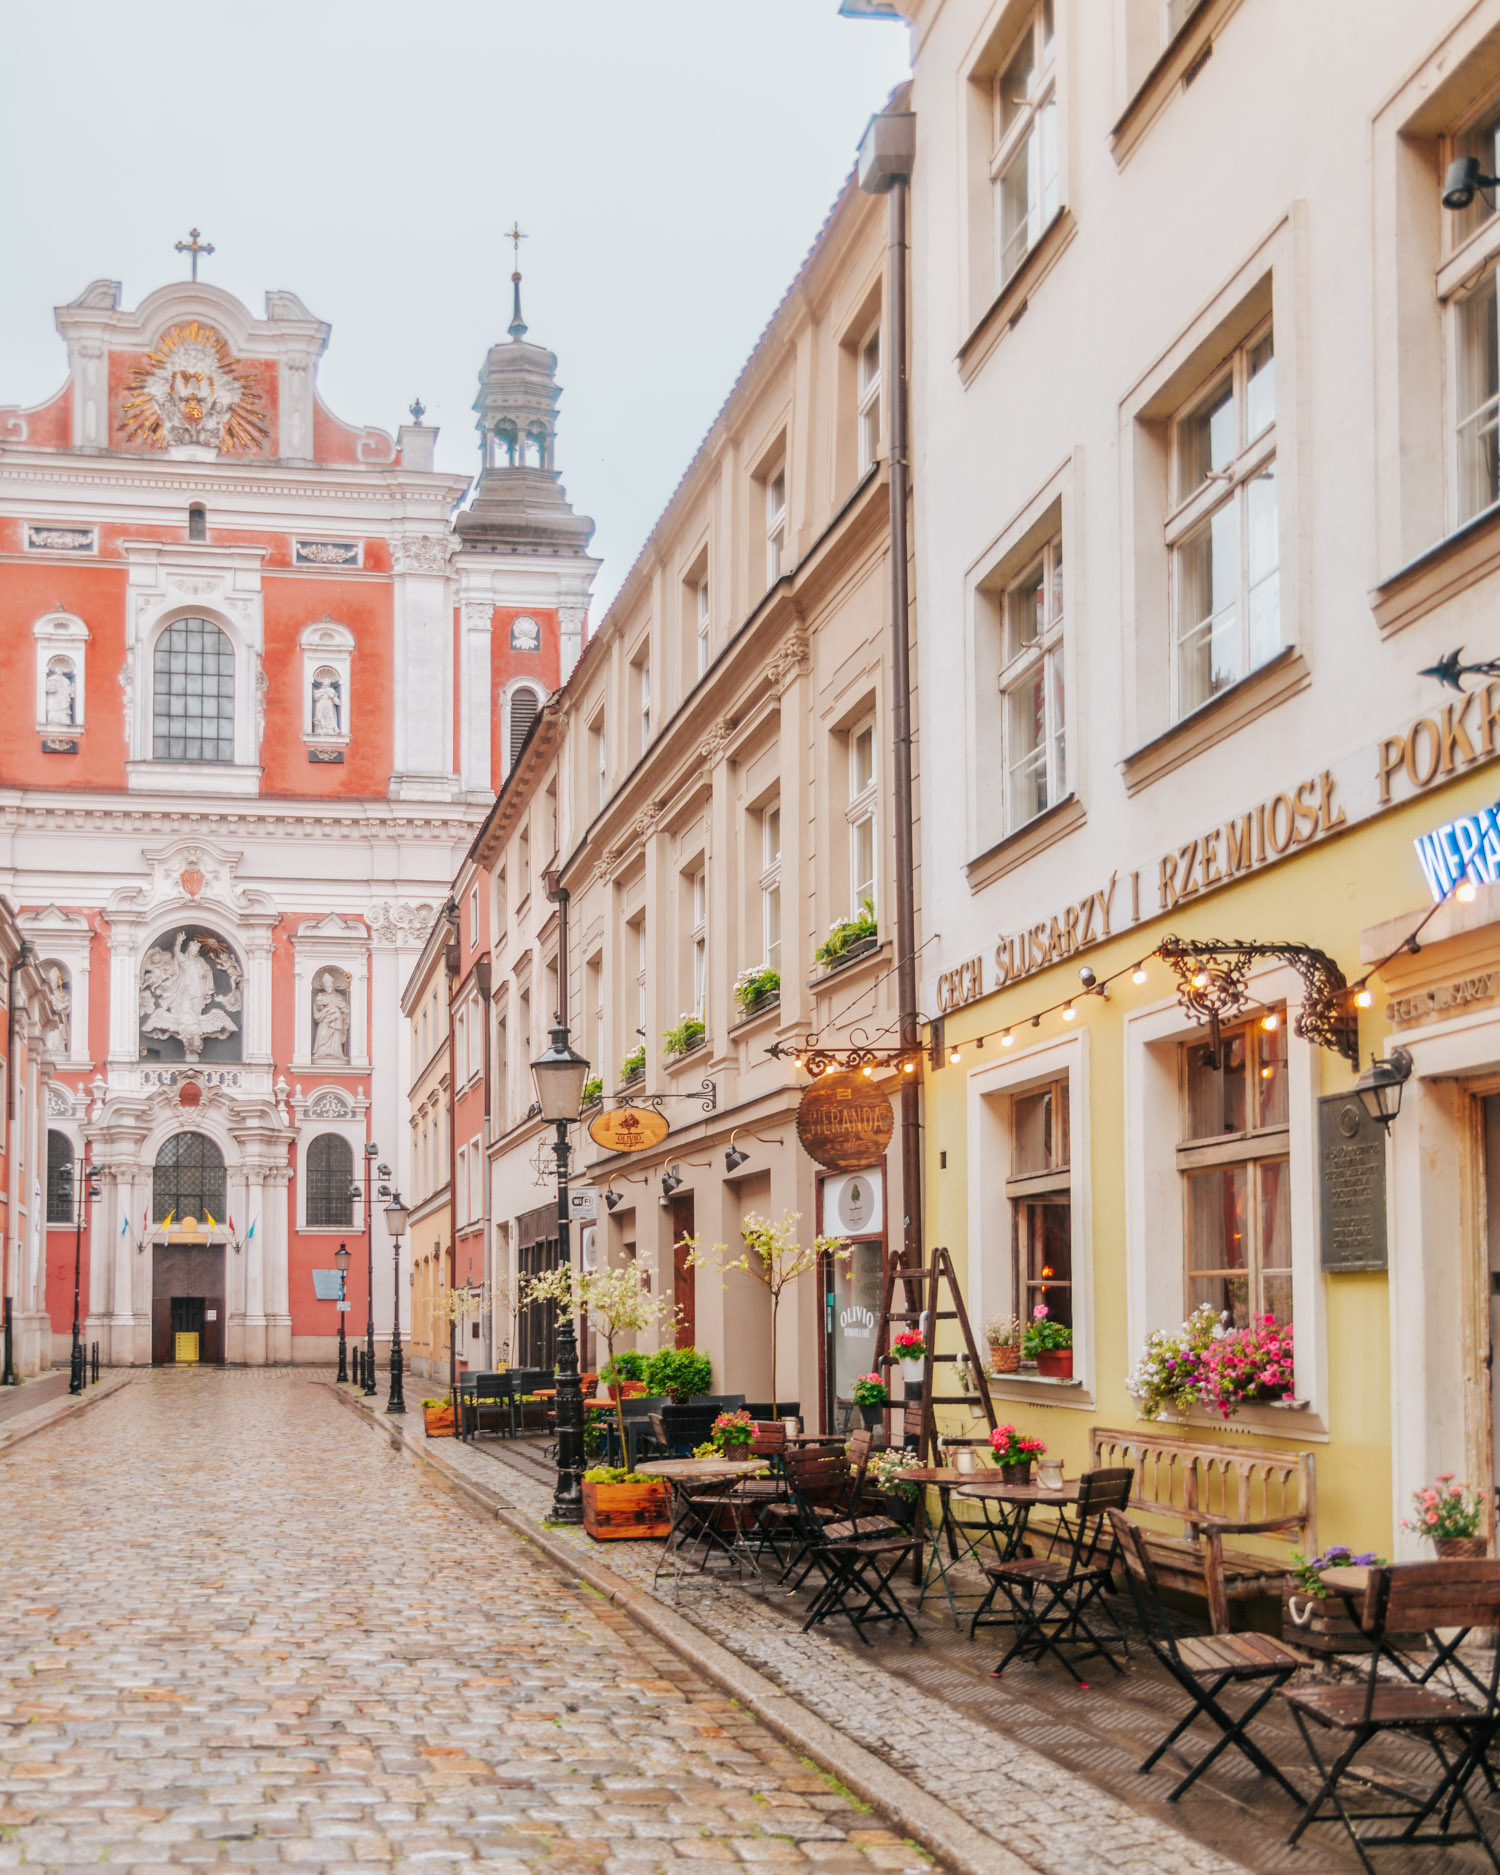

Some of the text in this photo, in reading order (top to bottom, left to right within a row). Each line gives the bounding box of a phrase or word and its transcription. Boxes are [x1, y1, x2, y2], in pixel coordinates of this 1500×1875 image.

[1413, 806, 1500, 904] WERA
[936, 954, 983, 1013] CECH
[994, 869, 1118, 987] ŚLUSARZY
[1129, 870, 1140, 922] I
[1157, 769, 1348, 909] RZEMIOSŁ
[808, 1106, 884, 1136] WERANDA
[617, 1134, 642, 1143] OLIVIO
[840, 1306, 874, 1328] OLIVIO
